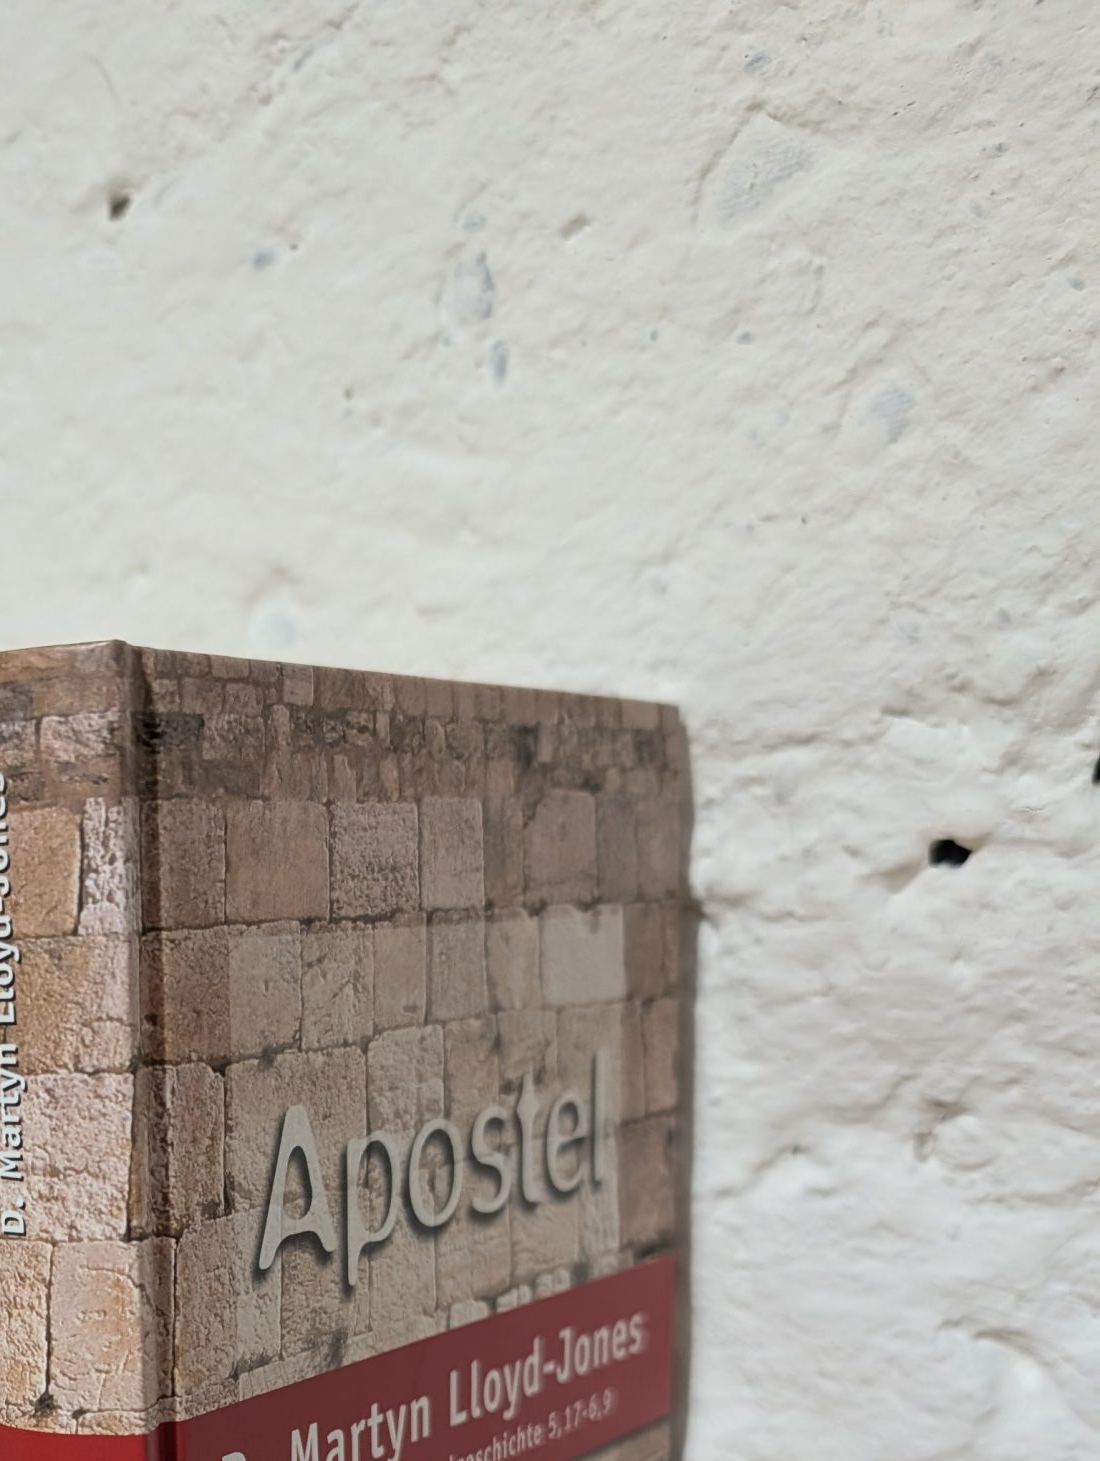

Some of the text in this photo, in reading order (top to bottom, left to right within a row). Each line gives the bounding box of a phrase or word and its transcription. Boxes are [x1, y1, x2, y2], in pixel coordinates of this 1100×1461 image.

[1, 1200, 27, 1238] D.
[257, 1053, 605, 1287] Apostel
[448, 1311, 647, 1428] Lloyd-Jones
